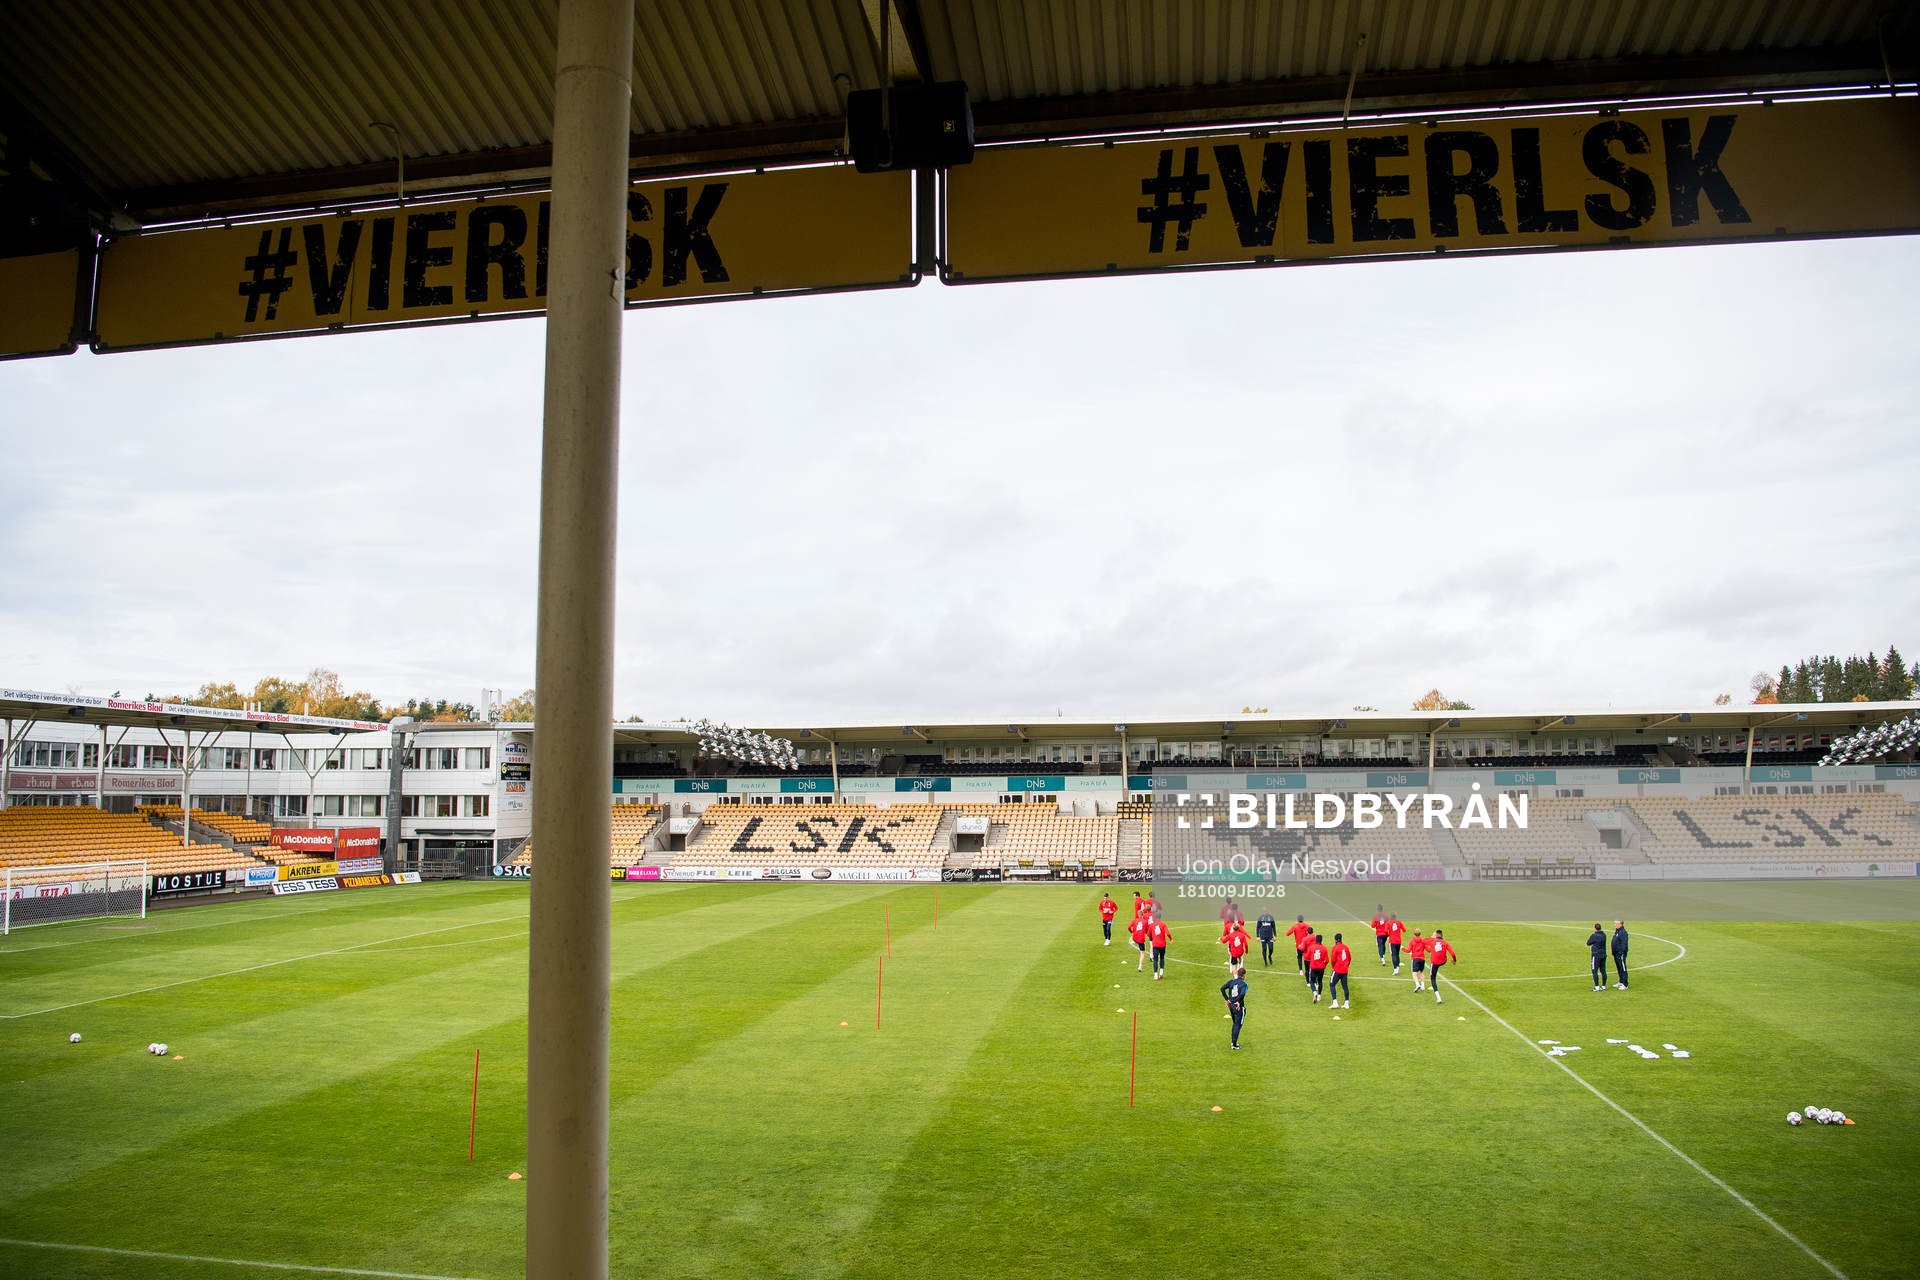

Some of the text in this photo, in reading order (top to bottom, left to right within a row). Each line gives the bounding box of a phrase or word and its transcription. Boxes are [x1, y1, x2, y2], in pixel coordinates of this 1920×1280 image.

[1136, 114, 1753, 253] #VIERLSK
[108, 700, 146, 711] Romerikes
[147, 701, 163, 712] Blad
[246, 711, 277, 721] Romerikes
[277, 713, 290, 722] Blad
[1514, 771, 1536, 784] DNB
[1638, 770, 1660, 783] DNB
[1770, 766, 1790, 780] DNB
[1896, 766, 1918, 779] DNB
[112, 778, 176, 789] Romerikes Blad
[692, 780, 710, 792] DNB
[798, 780, 816, 792] DNB
[914, 778, 933, 791] DNB
[1026, 777, 1046, 790] DNB
[1148, 776, 1168, 789] DNB
[1266, 775, 1286, 788] DNB
[1386, 773, 1407, 787] DNB
[284, 835, 332, 845] McDonald's
[346, 838, 378, 848] McDonald's
[290, 866, 321, 877] ÅKRENE
[157, 872, 222, 890] MOSTUE
[274, 882, 306, 892] TESS
[306, 878, 337, 890] TESS
